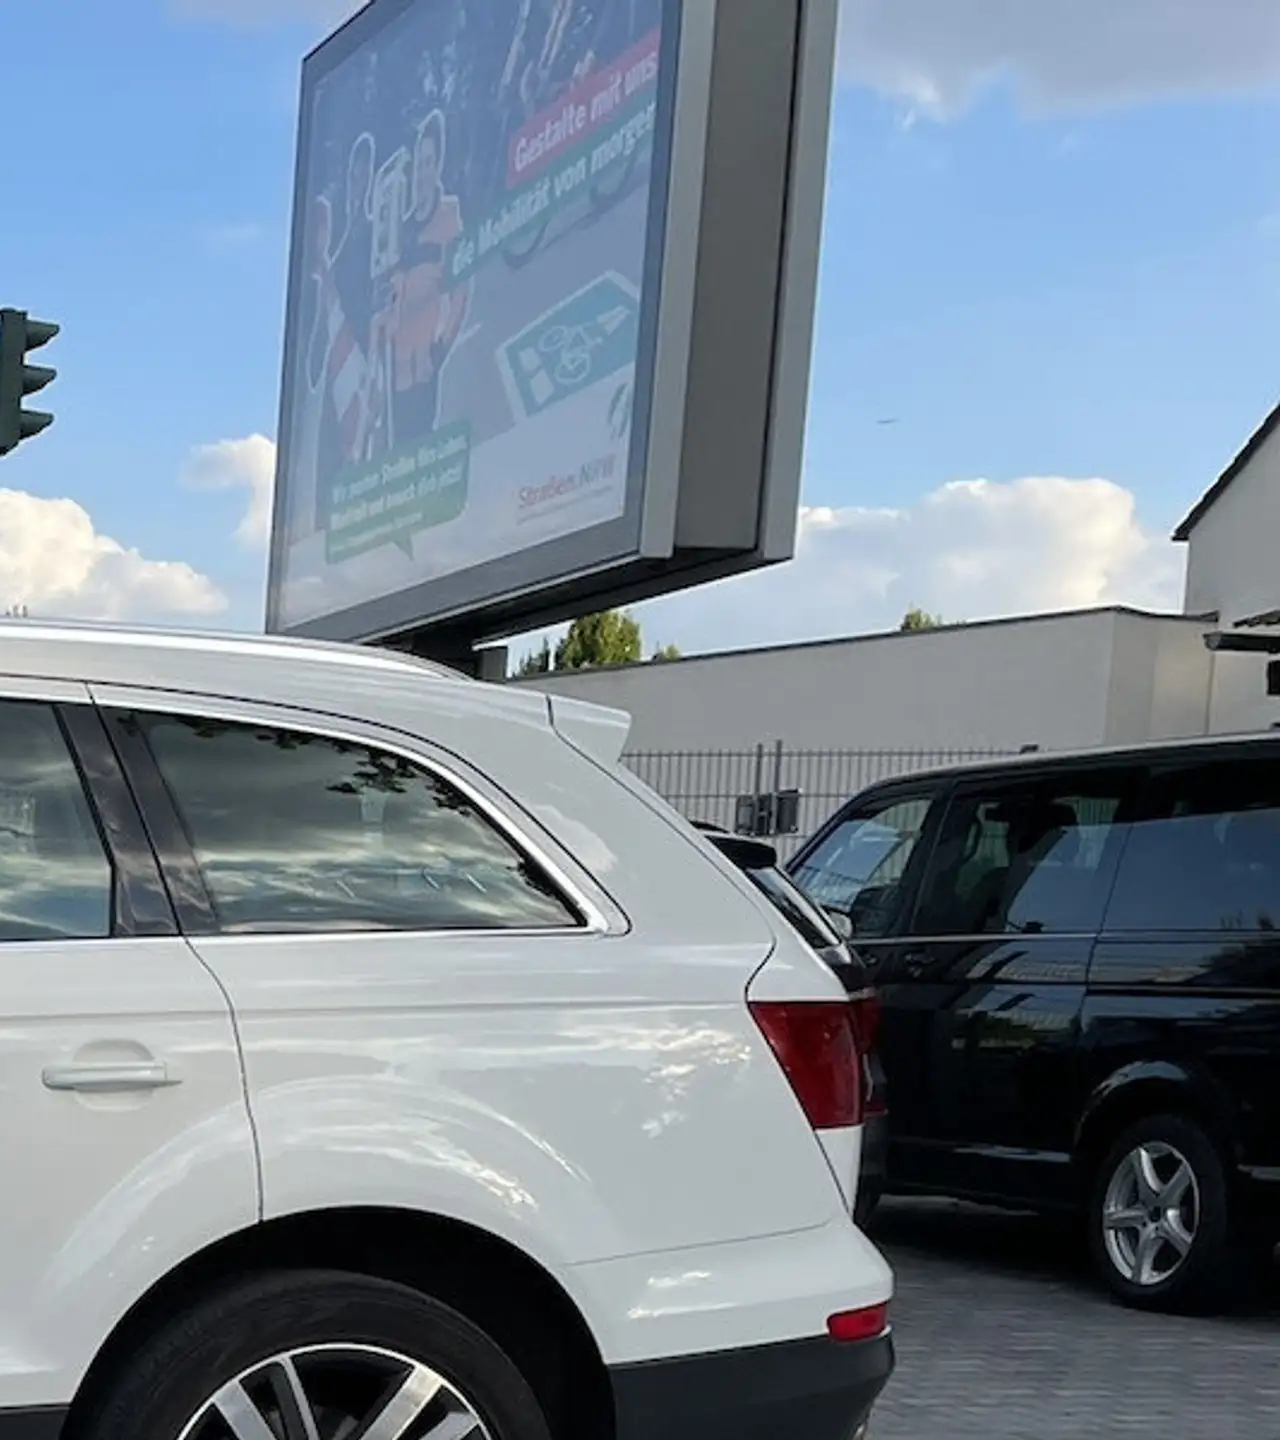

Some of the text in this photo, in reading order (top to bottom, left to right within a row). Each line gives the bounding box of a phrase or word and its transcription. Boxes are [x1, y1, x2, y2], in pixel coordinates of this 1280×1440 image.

[515, 51, 658, 172] Gestalte mit uns
[554, 156, 588, 198] von
